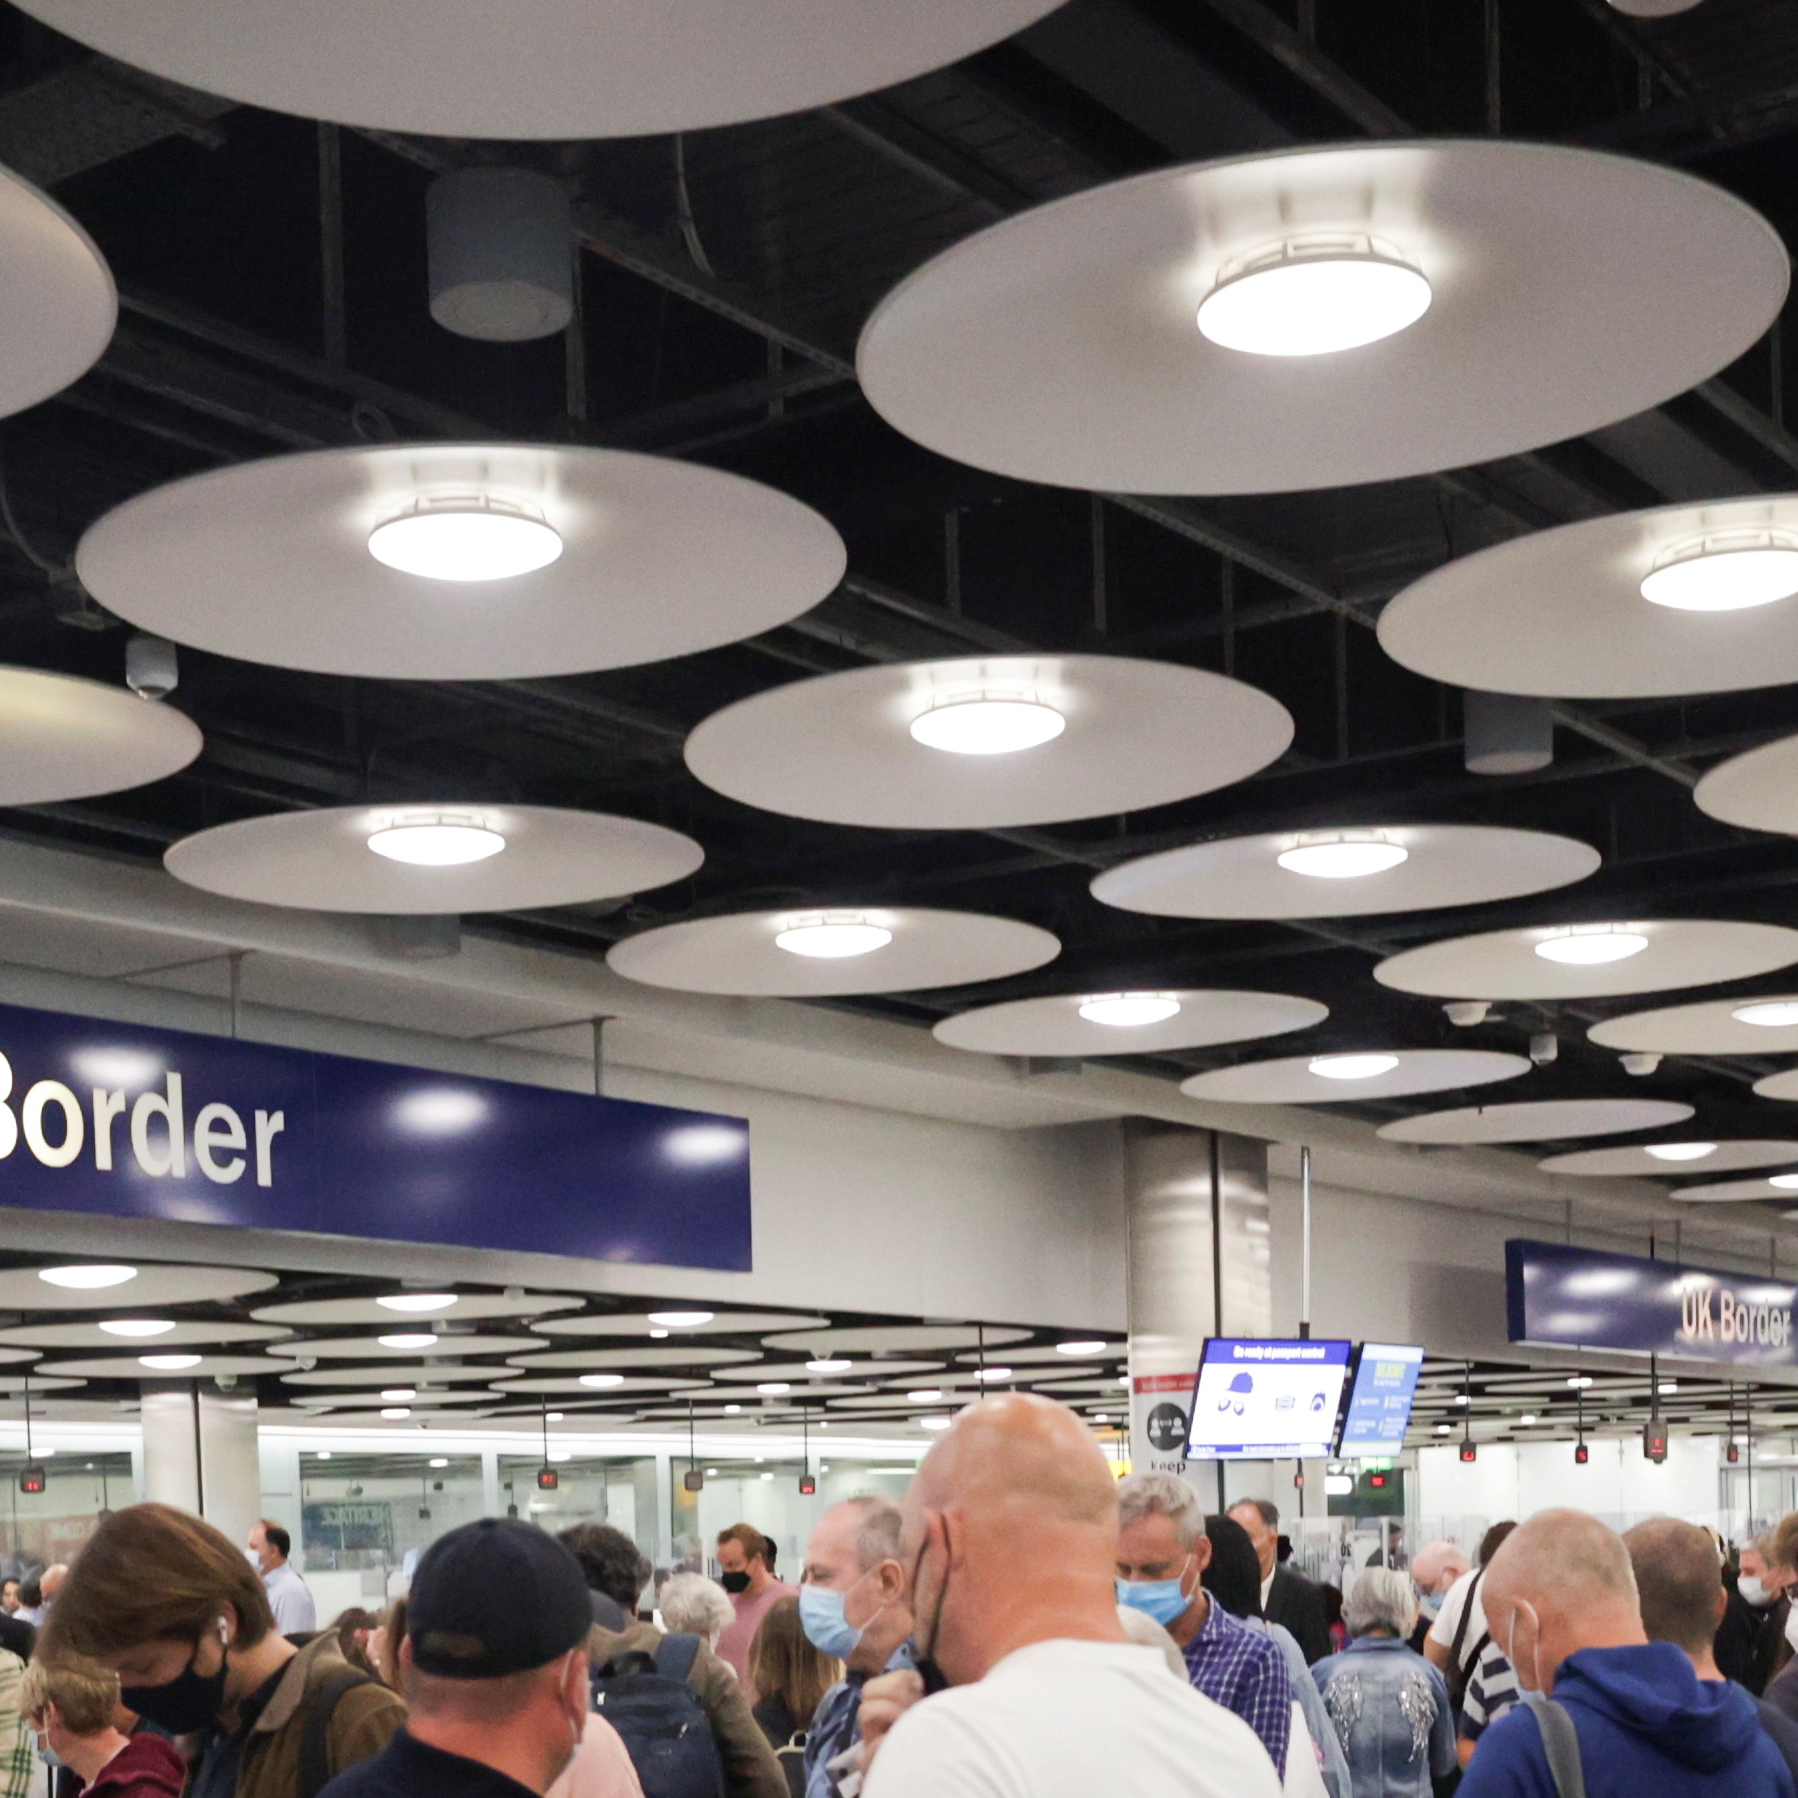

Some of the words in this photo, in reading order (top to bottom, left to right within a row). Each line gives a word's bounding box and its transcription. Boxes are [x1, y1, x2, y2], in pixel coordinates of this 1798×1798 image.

[1682, 1287, 1714, 1341] UK
[1721, 1289, 1791, 1347] Border
[1150, 1460, 1186, 1475] Keep
